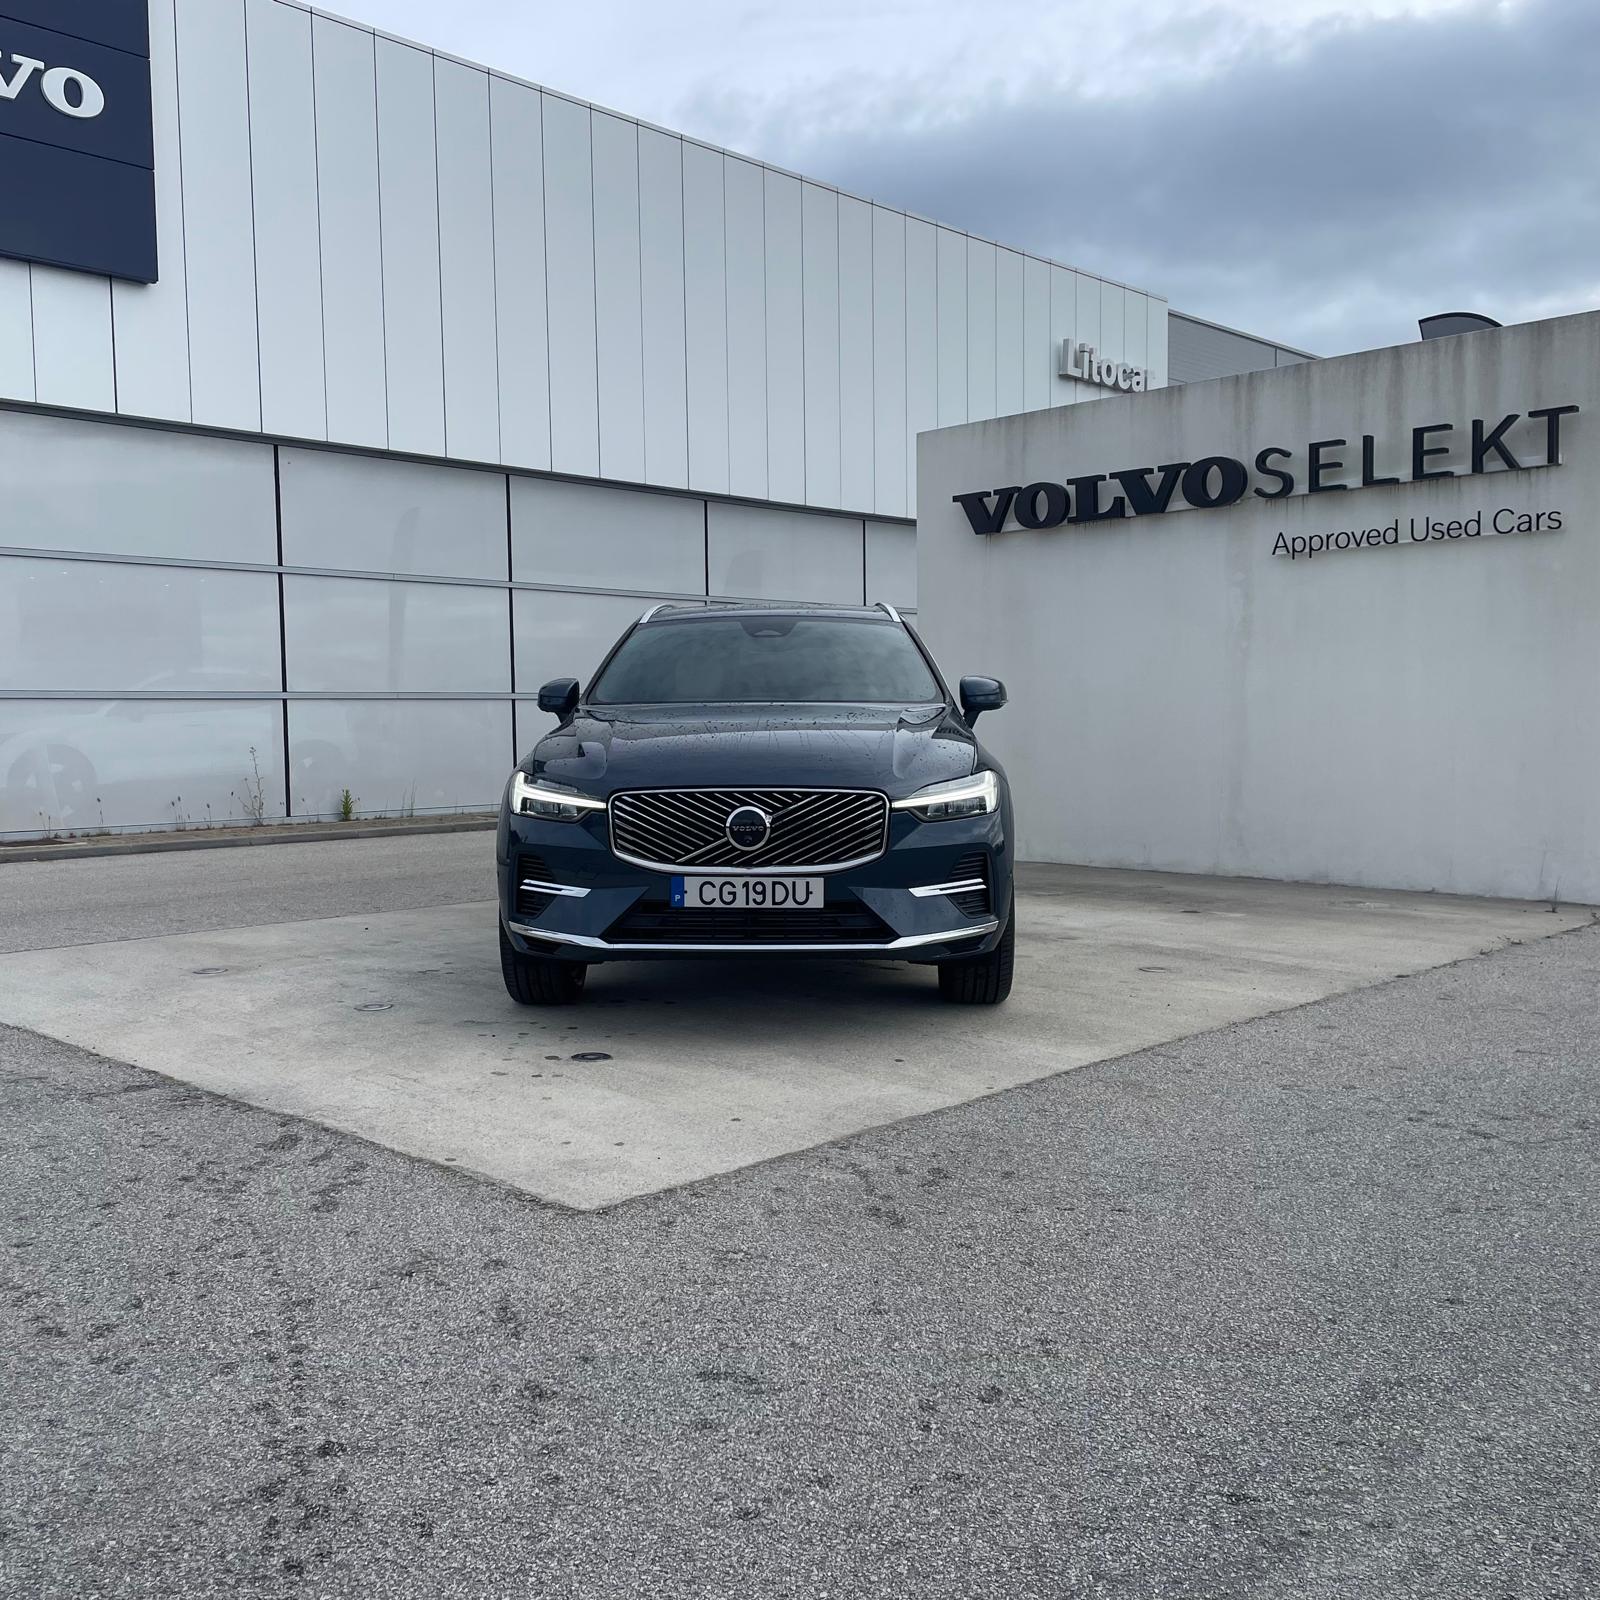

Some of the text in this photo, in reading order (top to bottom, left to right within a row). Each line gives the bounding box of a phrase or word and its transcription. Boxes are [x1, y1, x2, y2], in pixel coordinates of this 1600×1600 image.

[952, 405, 1579, 535] VOLVO SELEKT
[1272, 508, 1562, 560] Approved Used Cars
